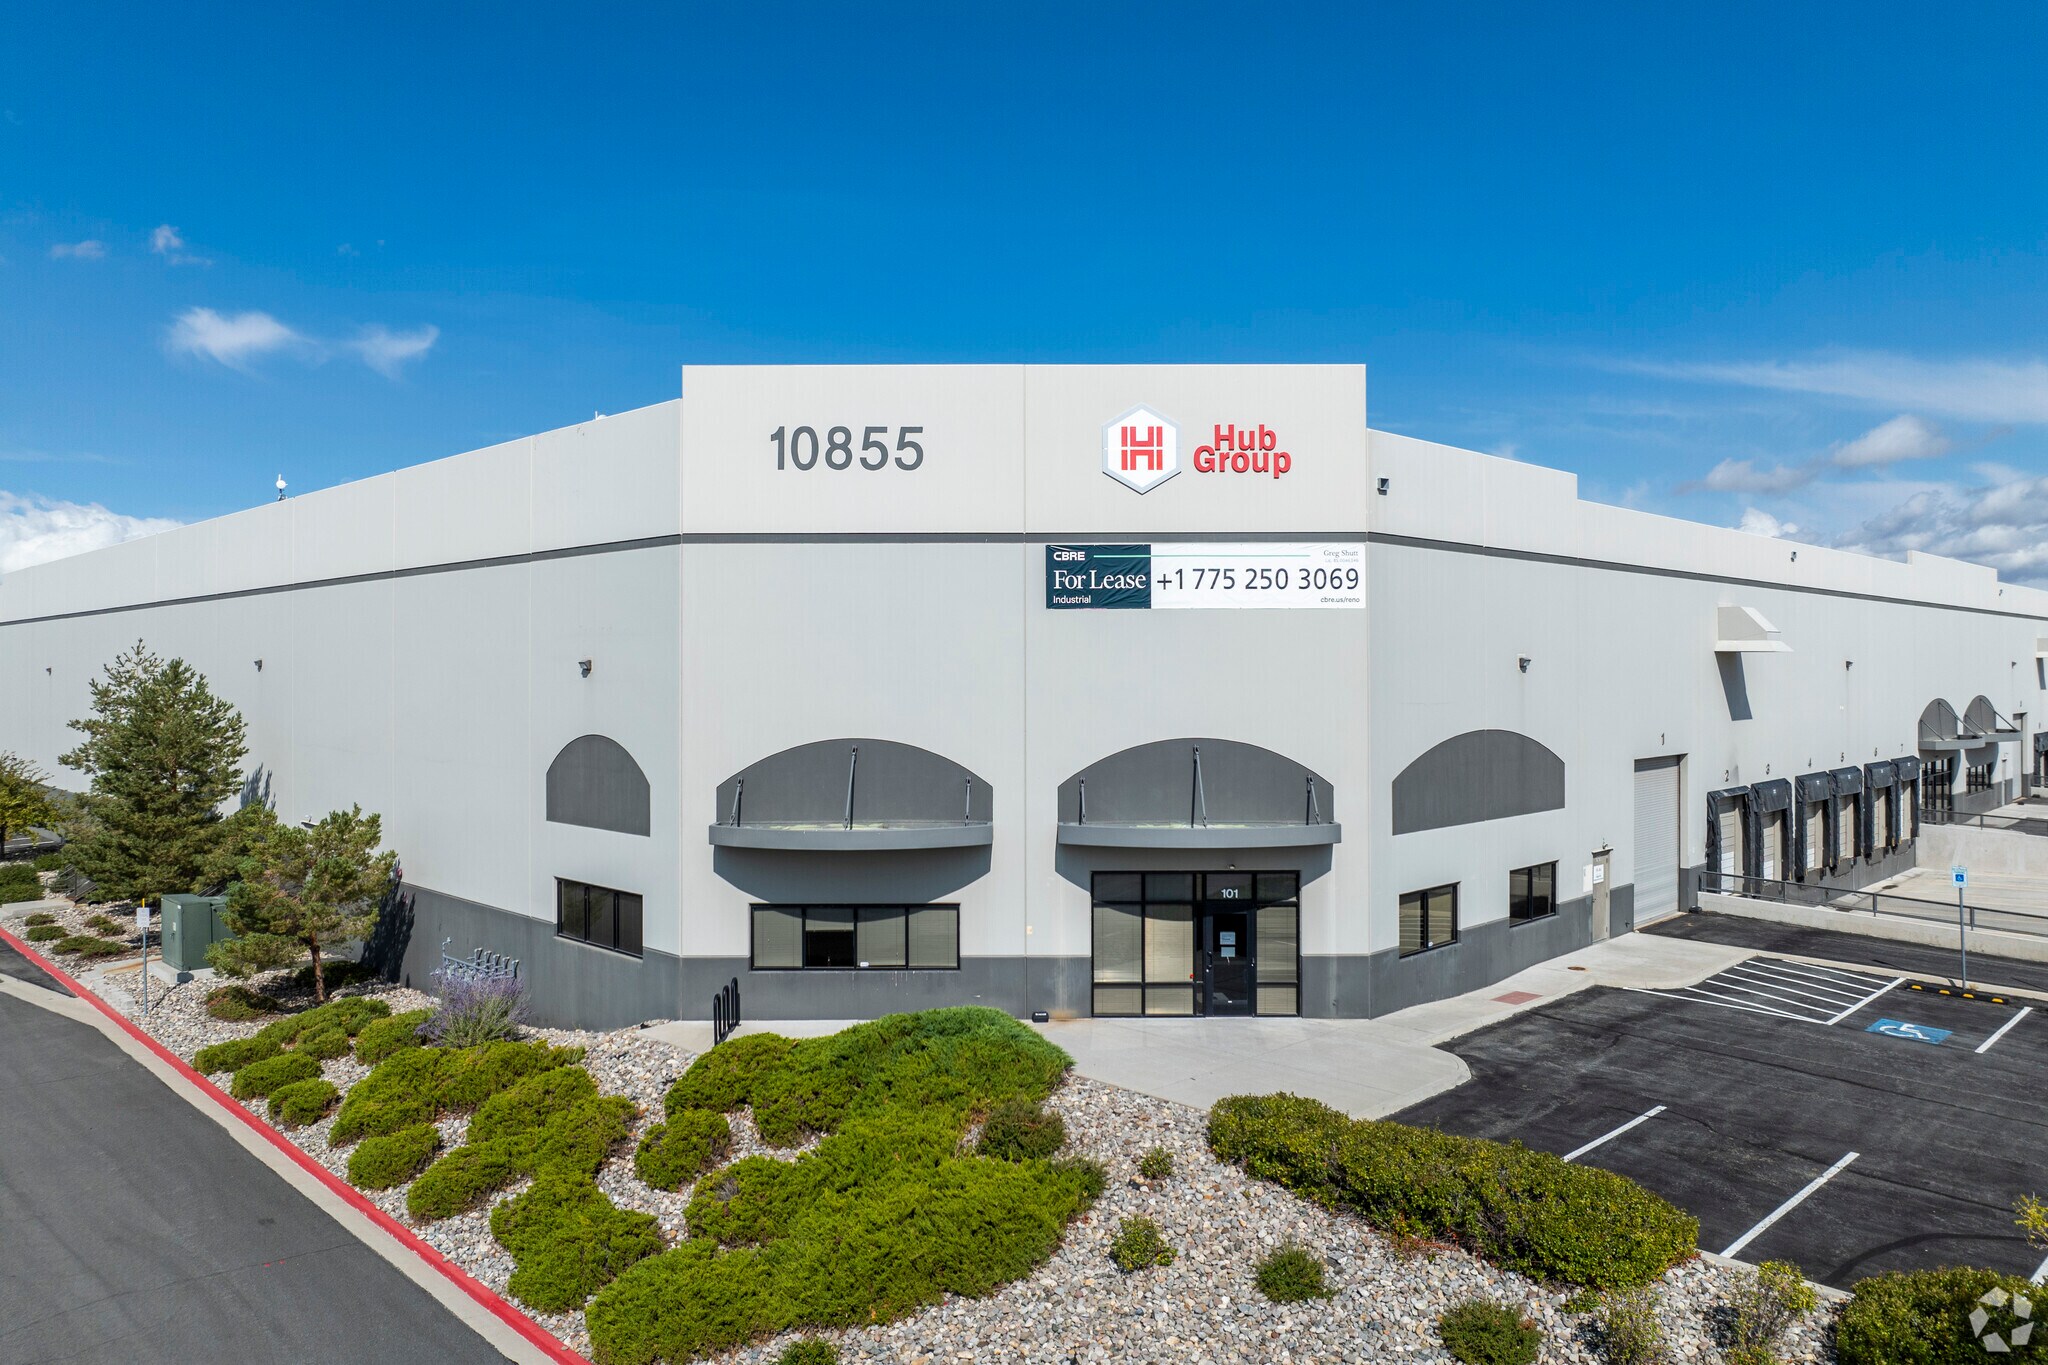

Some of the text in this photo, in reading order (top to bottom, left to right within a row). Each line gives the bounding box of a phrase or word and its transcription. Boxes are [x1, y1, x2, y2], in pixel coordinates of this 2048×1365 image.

[1214, 424, 1277, 451] Hub
[770, 425, 924, 471] 10855
[1193, 445, 1292, 479] Group
[1053, 551, 1086, 561] CBRE
[1323, 549, 1340, 558] Greg
[1053, 569, 1147, 589] For Lease
[1156, 568, 1359, 590] +1 775 250 3069
[1053, 595, 1092, 604] Industrial
[1320, 596, 1361, 604] cbre.us/reno
[1660, 732, 1665, 746] 1
[1724, 769, 1730, 782] 2
[1221, 888, 1239, 898] 101
